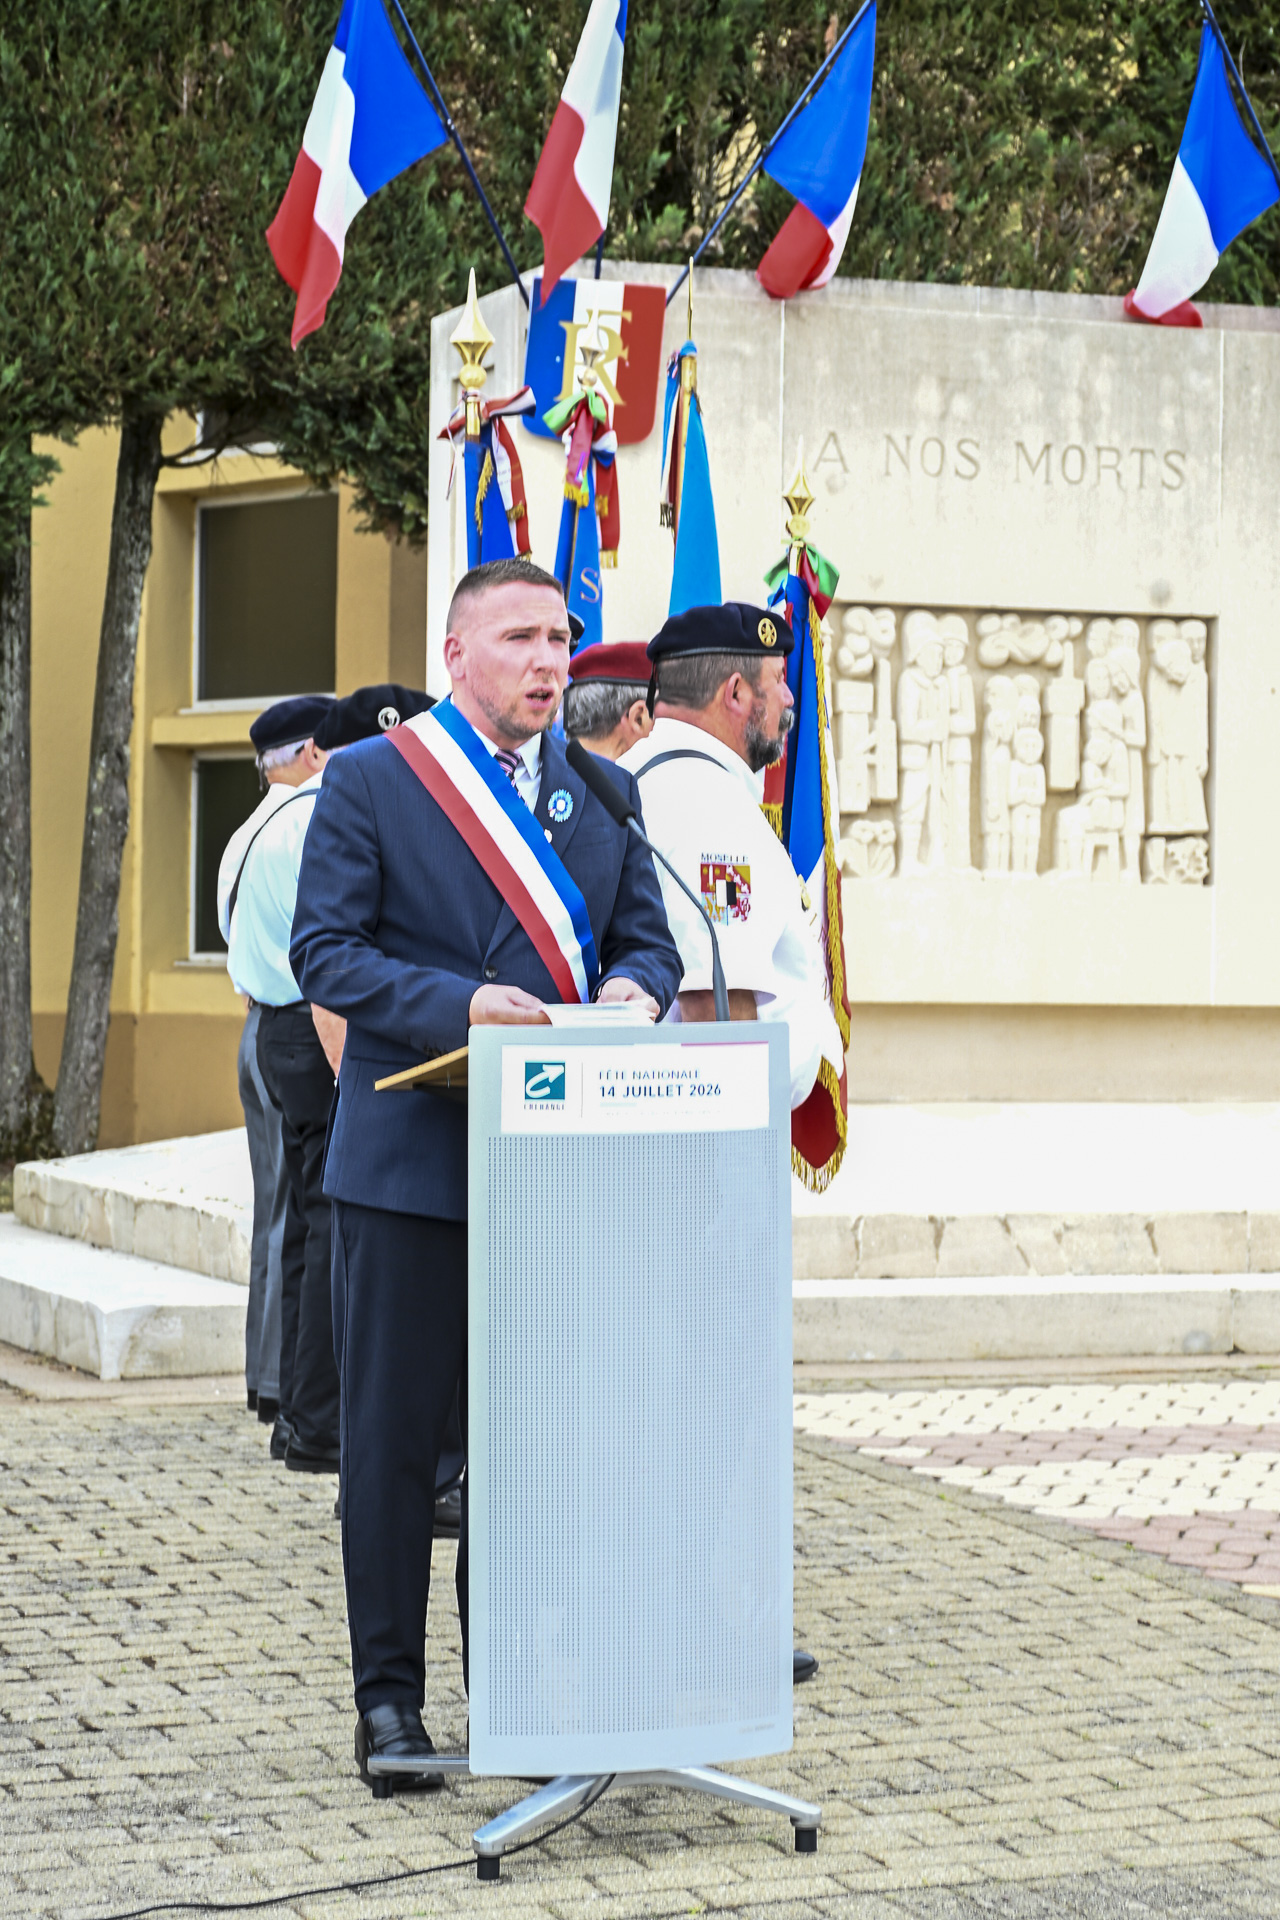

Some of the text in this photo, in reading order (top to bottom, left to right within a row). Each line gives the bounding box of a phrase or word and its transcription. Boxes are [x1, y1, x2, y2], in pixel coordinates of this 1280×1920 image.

[813, 431, 1187, 492] A NOS MORTS
[632, 1068, 700, 1080] NATIONALE
[599, 1083, 721, 1098] 14 JUILLET 2026
